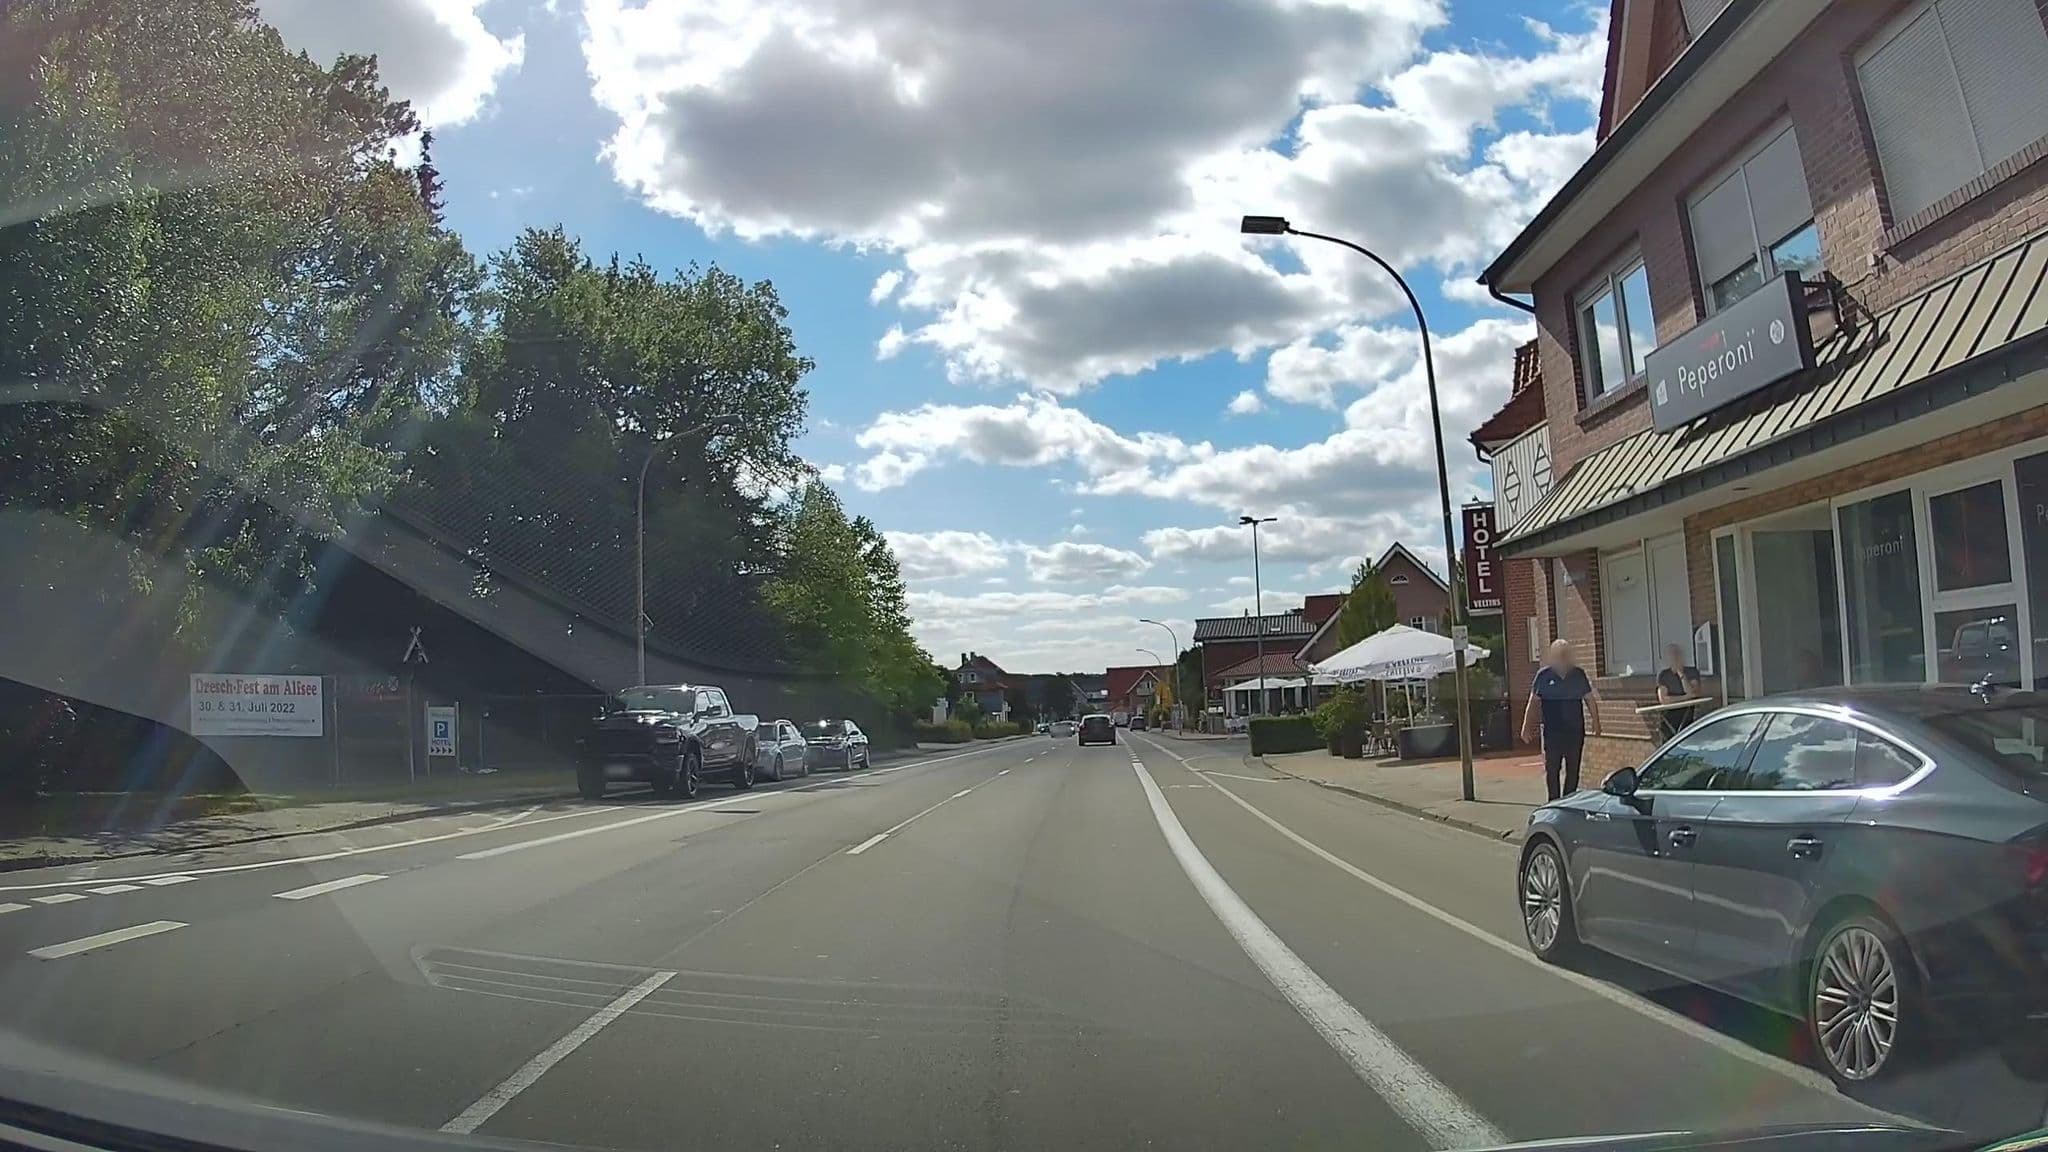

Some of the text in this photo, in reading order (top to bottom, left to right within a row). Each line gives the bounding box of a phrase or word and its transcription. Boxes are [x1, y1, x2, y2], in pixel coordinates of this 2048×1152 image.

[1472, 512, 1492, 593] HOTEL
[263, 684, 280, 695] am
[283, 680, 317, 696] Alfsee
[199, 701, 296, 714] 30. & 31. Juli 2022
